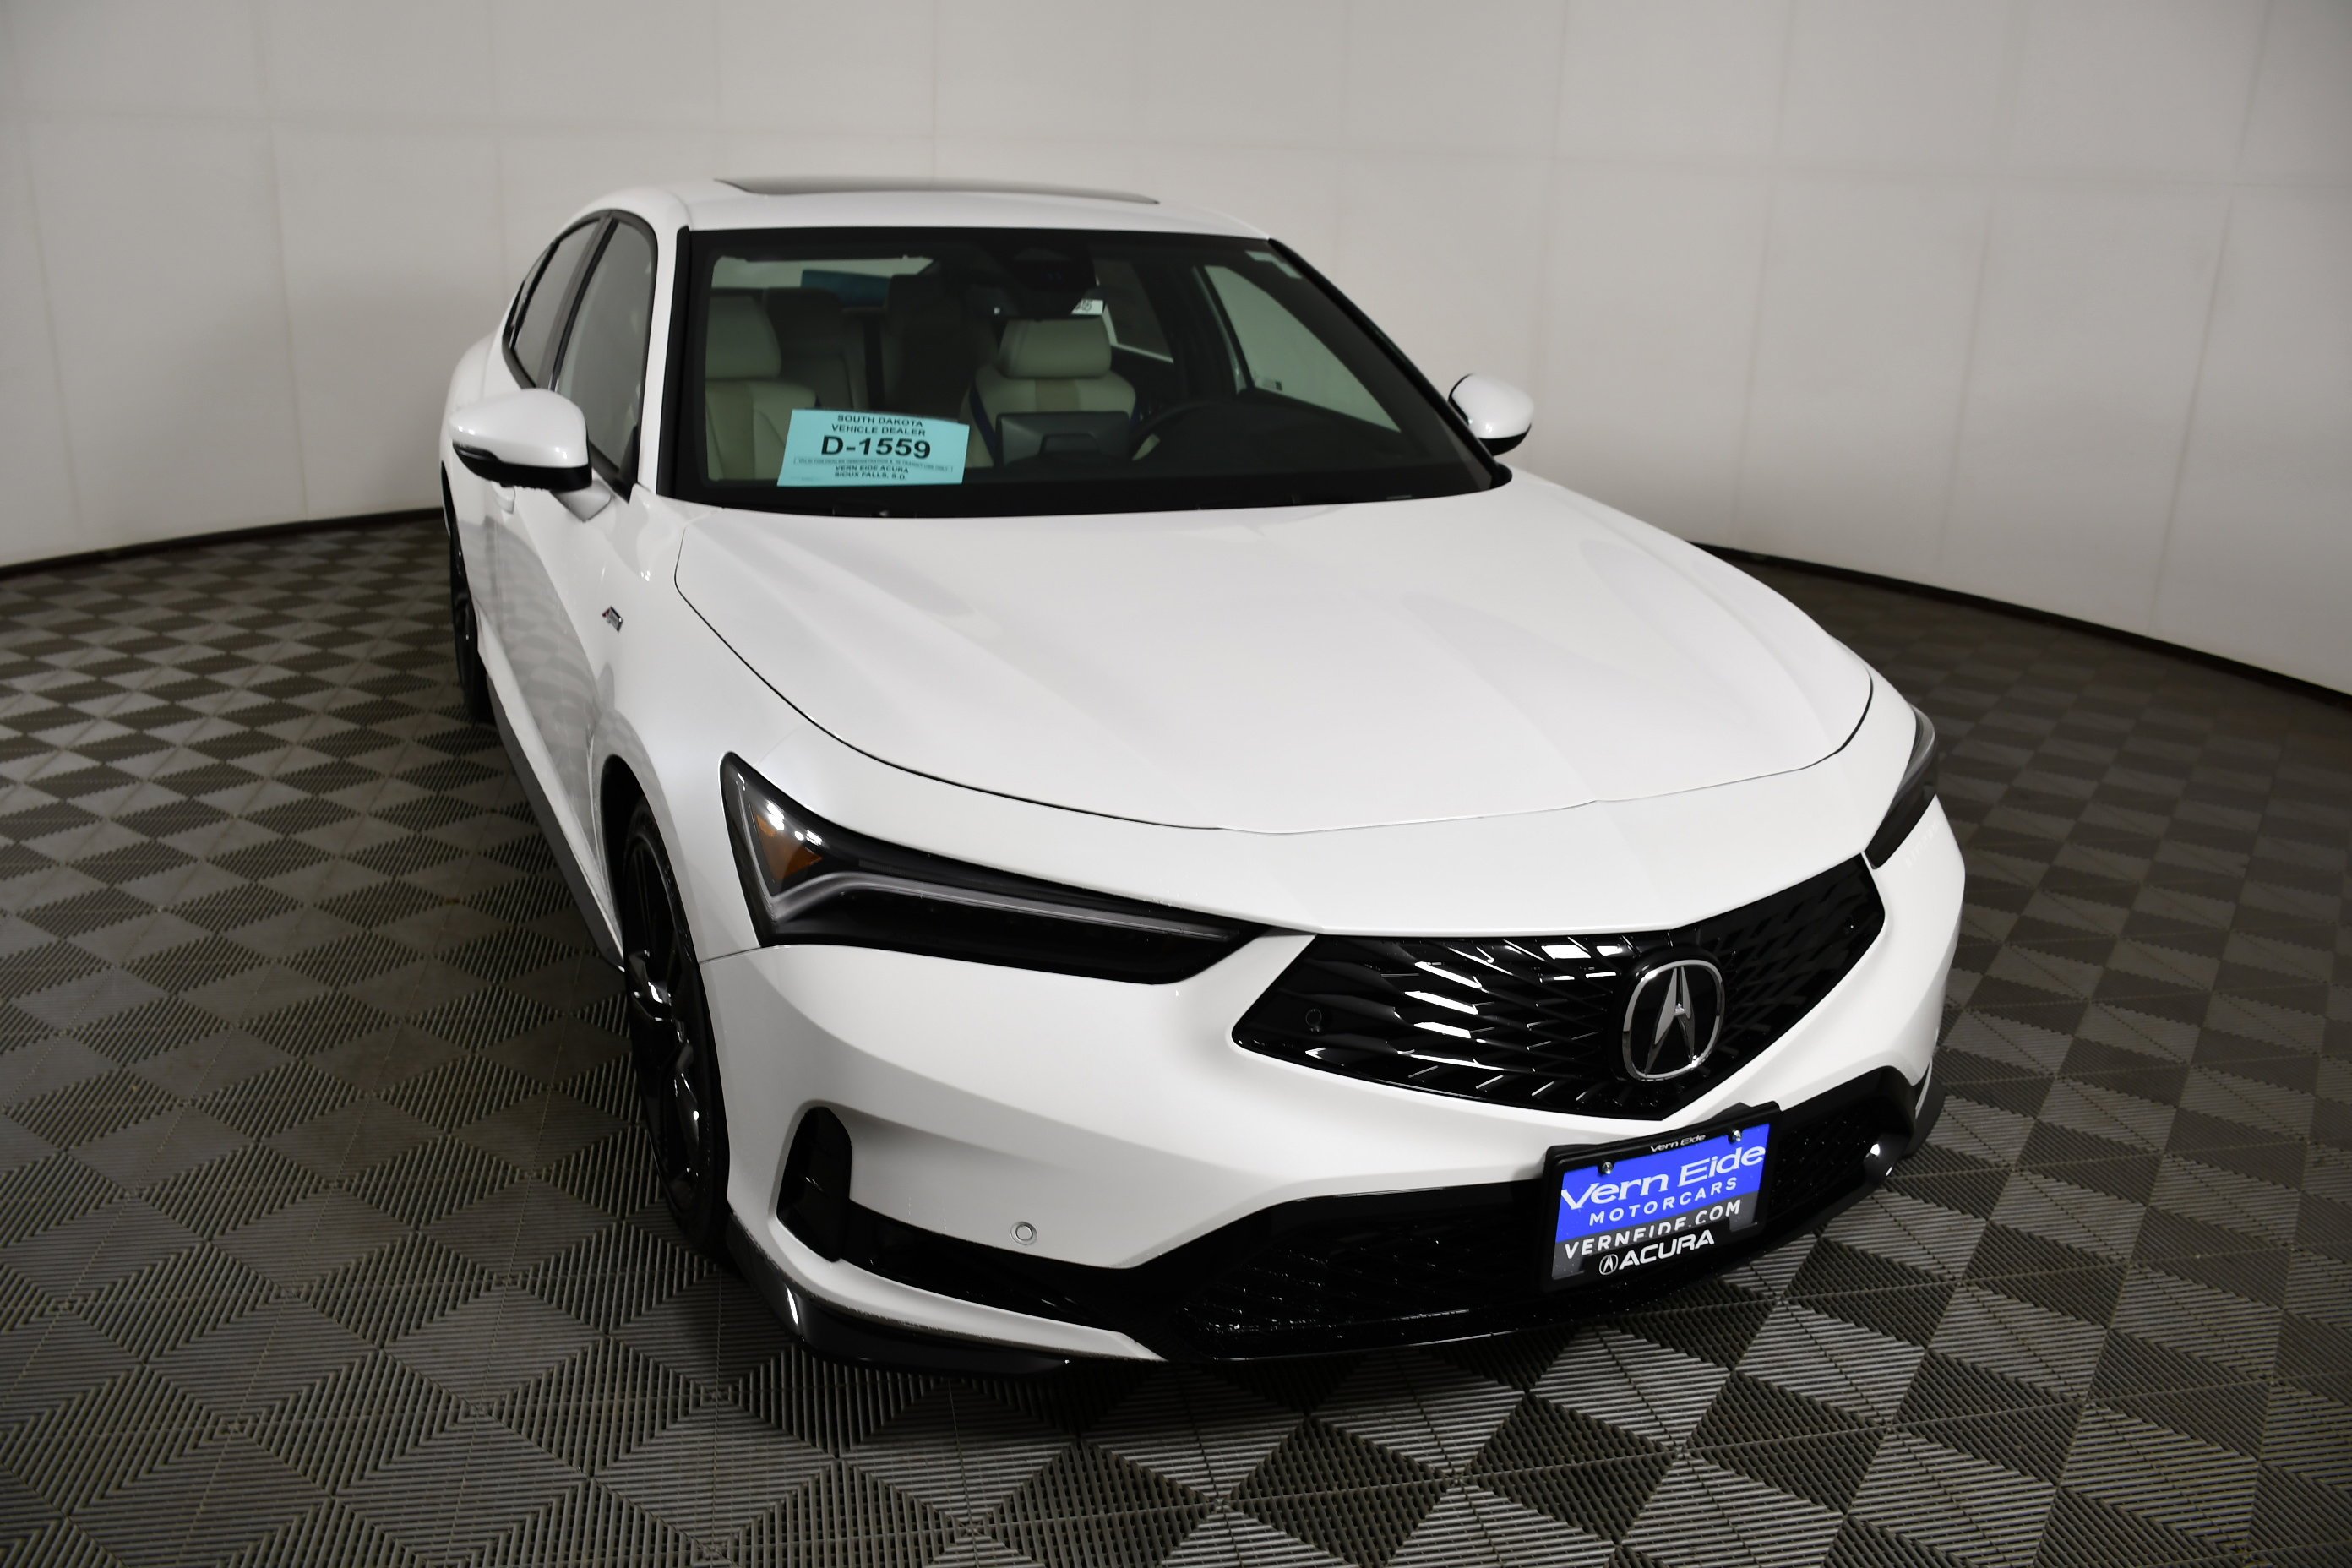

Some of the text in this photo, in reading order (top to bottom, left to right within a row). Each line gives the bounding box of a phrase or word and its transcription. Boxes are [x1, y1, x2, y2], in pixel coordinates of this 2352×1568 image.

[831, 424, 926, 436] VEHICLE DEALER
[838, 415, 923, 427] SOUTH DAKOTA
[821, 435, 931, 459] D-1559
[1650, 1134, 1706, 1152] Vern Eide
[1561, 1146, 1766, 1210] Vern Eide
[1589, 1177, 1737, 1227] MOTORCARS
[1619, 1229, 1715, 1270] ACURA
